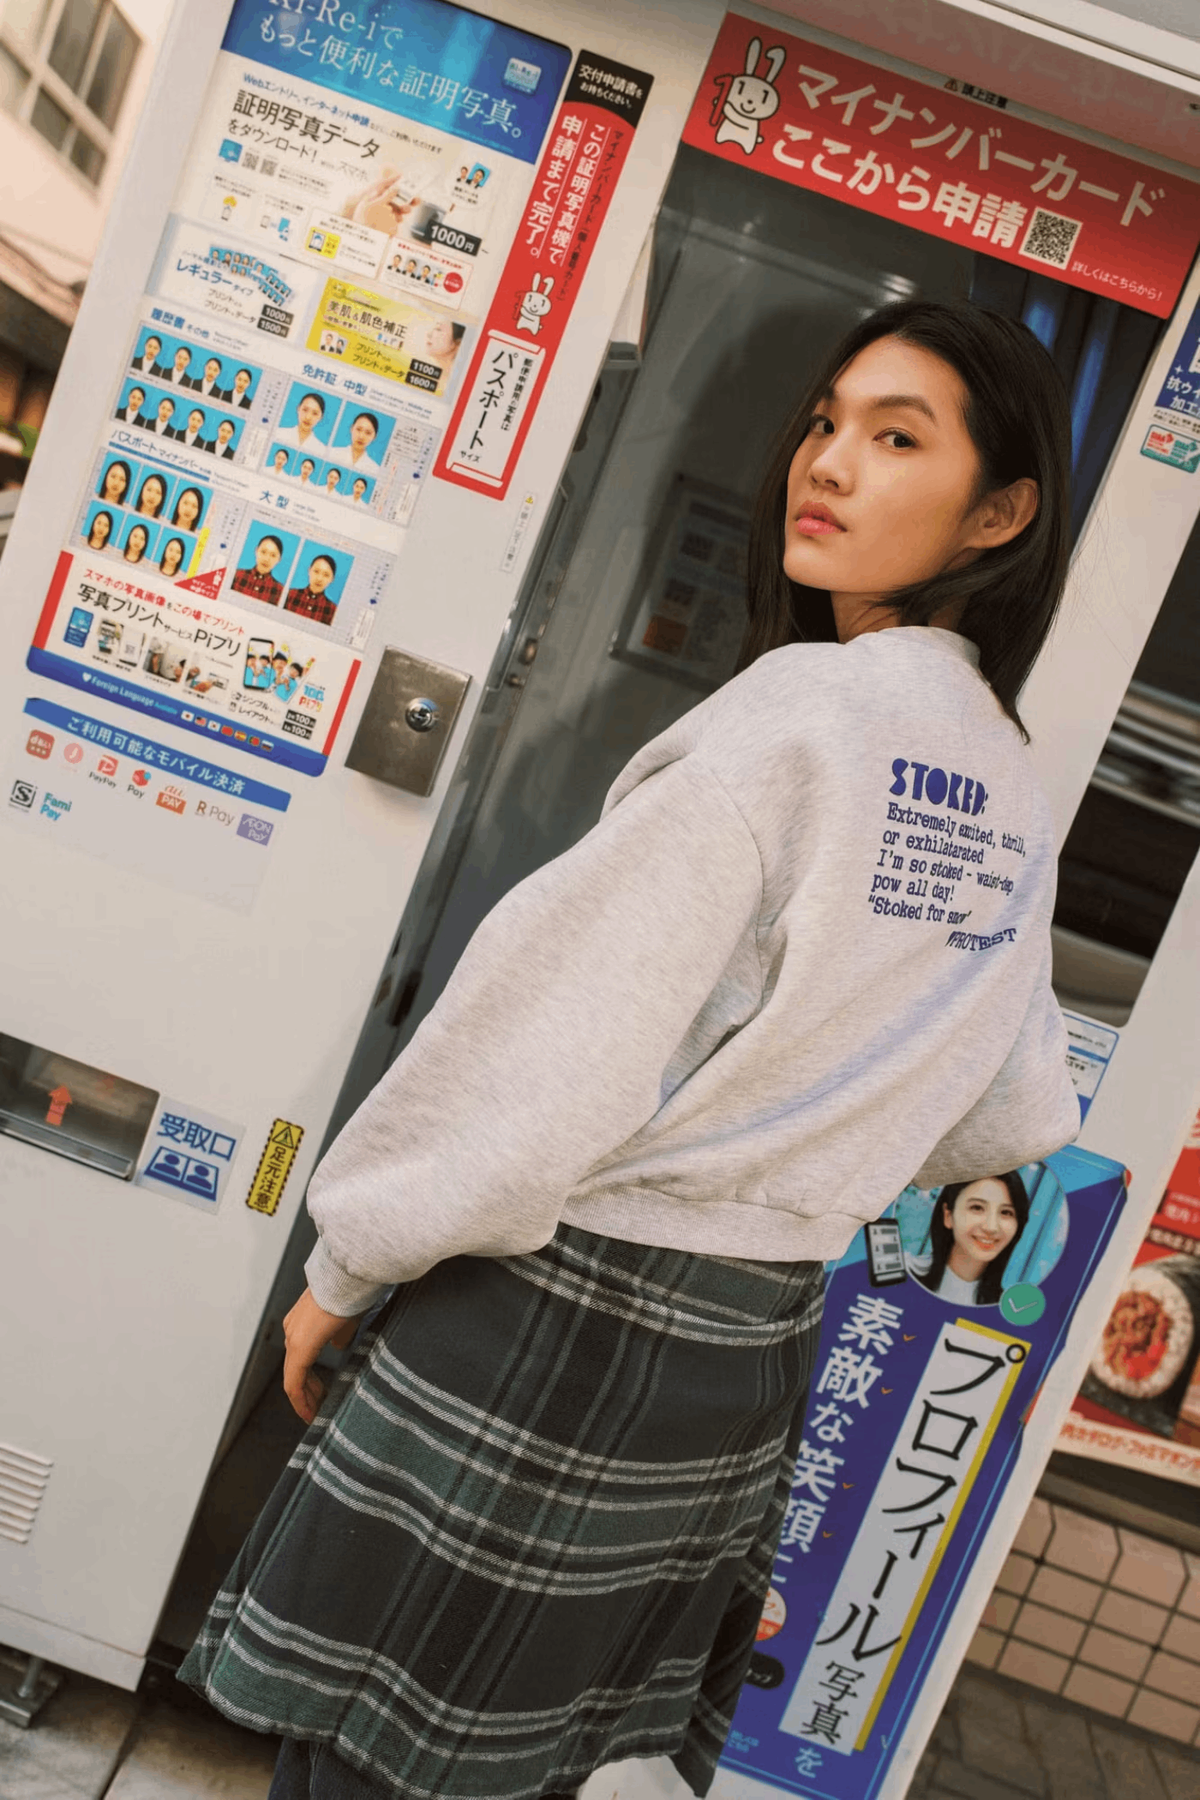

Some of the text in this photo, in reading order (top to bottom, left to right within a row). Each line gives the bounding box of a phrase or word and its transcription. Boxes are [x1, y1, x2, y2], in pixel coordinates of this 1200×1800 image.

[261, 14, 522, 139] もっと便利な証明写真。
[578, 64, 644, 100] 交付申請書を
[580, 81, 633, 109] お持ちください。
[233, 89, 381, 158] 証明写真データ
[798, 64, 1166, 227] マイナンバーカード
[525, 115, 583, 257] 申請まで完了。
[549, 123, 605, 265] この証明写真機で
[772, 123, 1029, 248] ここから申請
[431, 224, 476, 253] 1000円
[1071, 260, 1163, 302] 詳しくはこちらから！
[470, 350, 519, 450] パスポート
[460, 450, 482, 463] サイズ
[66, 716, 246, 795] ご利用可能なモバイル決済
[89, 770, 118, 789] PayPay
[127, 784, 145, 800] Pay
[39, 803, 61, 822] Pay
[43, 792, 73, 812] Fami
[161, 793, 183, 810] PAY
[209, 805, 236, 827] Pay
[886, 802, 956, 838] Extremely
[883, 830, 900, 846] or
[876, 849, 905, 871] I'm
[909, 858, 928, 874] so
[929, 859, 964, 881] stoked
[870, 874, 955, 904] pow all day!
[926, 903, 946, 922] for
[156, 1111, 237, 1162] 受取口
[253, 1145, 287, 1209] 足元注意
